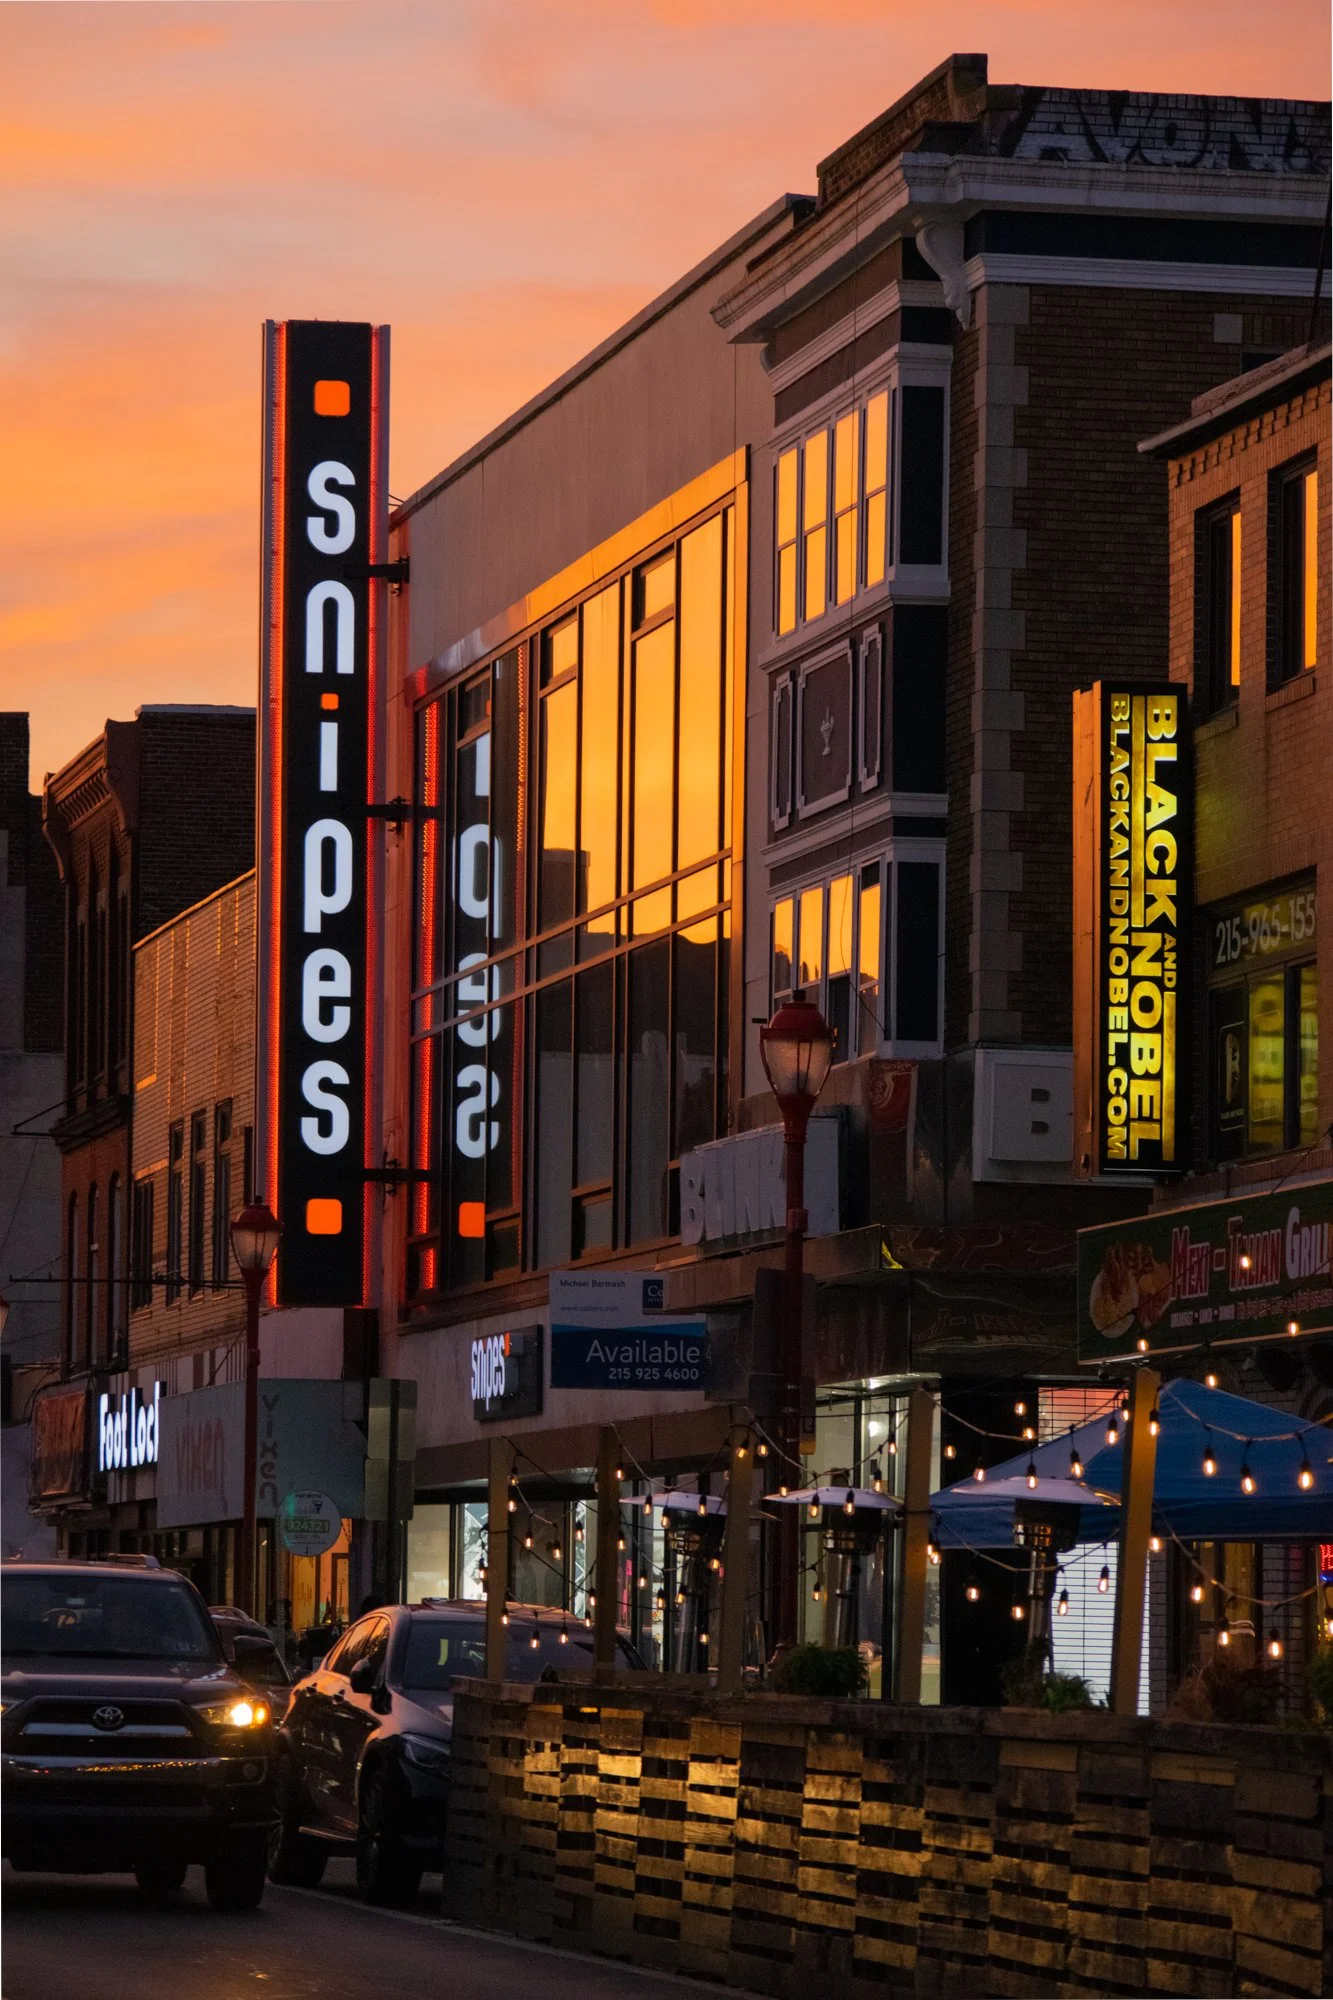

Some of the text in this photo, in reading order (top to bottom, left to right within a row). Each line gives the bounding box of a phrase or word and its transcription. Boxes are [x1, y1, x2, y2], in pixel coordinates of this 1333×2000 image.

[301, 461, 356, 1155] snipes
[1107, 693, 1131, 1161] BLACKANDNOBEL.COM
[1130, 695, 1179, 1162] BLACK AND NOBEL
[1215, 892, 1318, 966] 215-965-155
[1285, 1206, 1330, 1280] GRILL
[560, 1279, 626, 1288] Michael Barmash
[470, 1334, 506, 1411] snipes
[586, 1339, 701, 1363] Available
[608, 1368, 699, 1380] 215 925 4600
[100, 1393, 128, 1472] Foot
